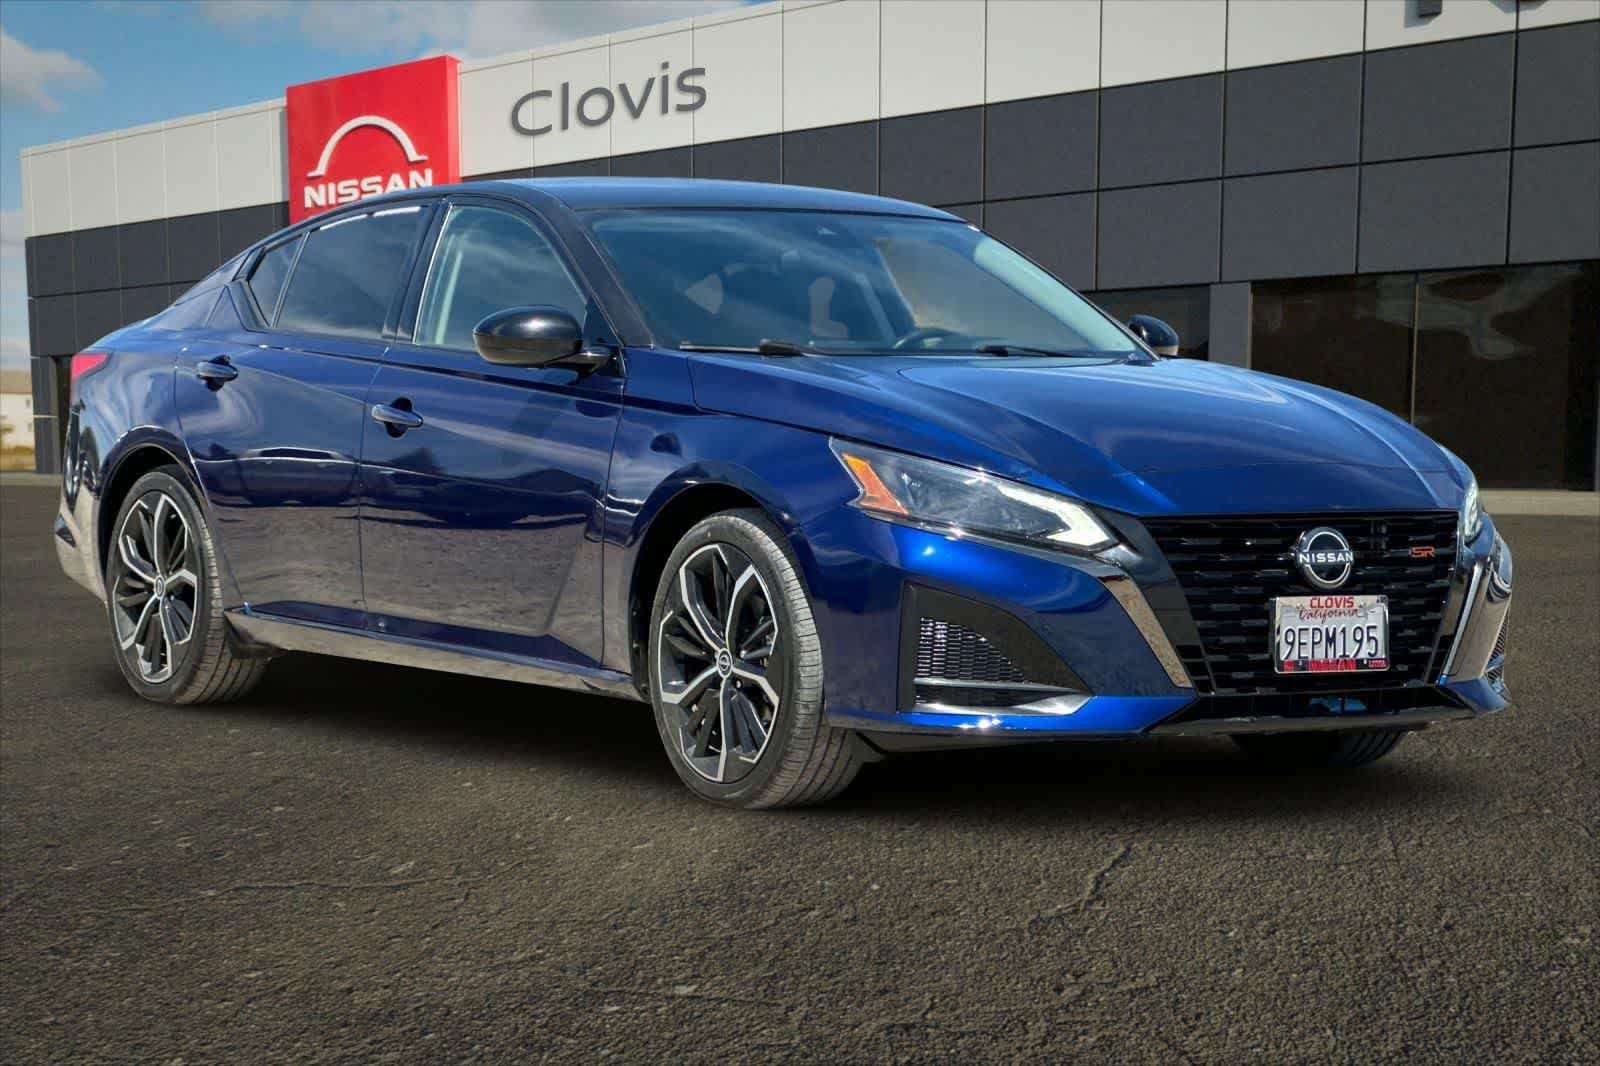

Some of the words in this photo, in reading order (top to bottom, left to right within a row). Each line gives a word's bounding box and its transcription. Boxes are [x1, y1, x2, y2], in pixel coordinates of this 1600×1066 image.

[511, 62, 707, 136] Clovis
[303, 168, 433, 209] NISSAN
[1299, 552, 1354, 563] NISSAN
[1410, 546, 1436, 557] SR
[1310, 597, 1354, 608] CLOVIS
[1299, 608, 1358, 623] California
[1284, 625, 1379, 660] 9EPM195
